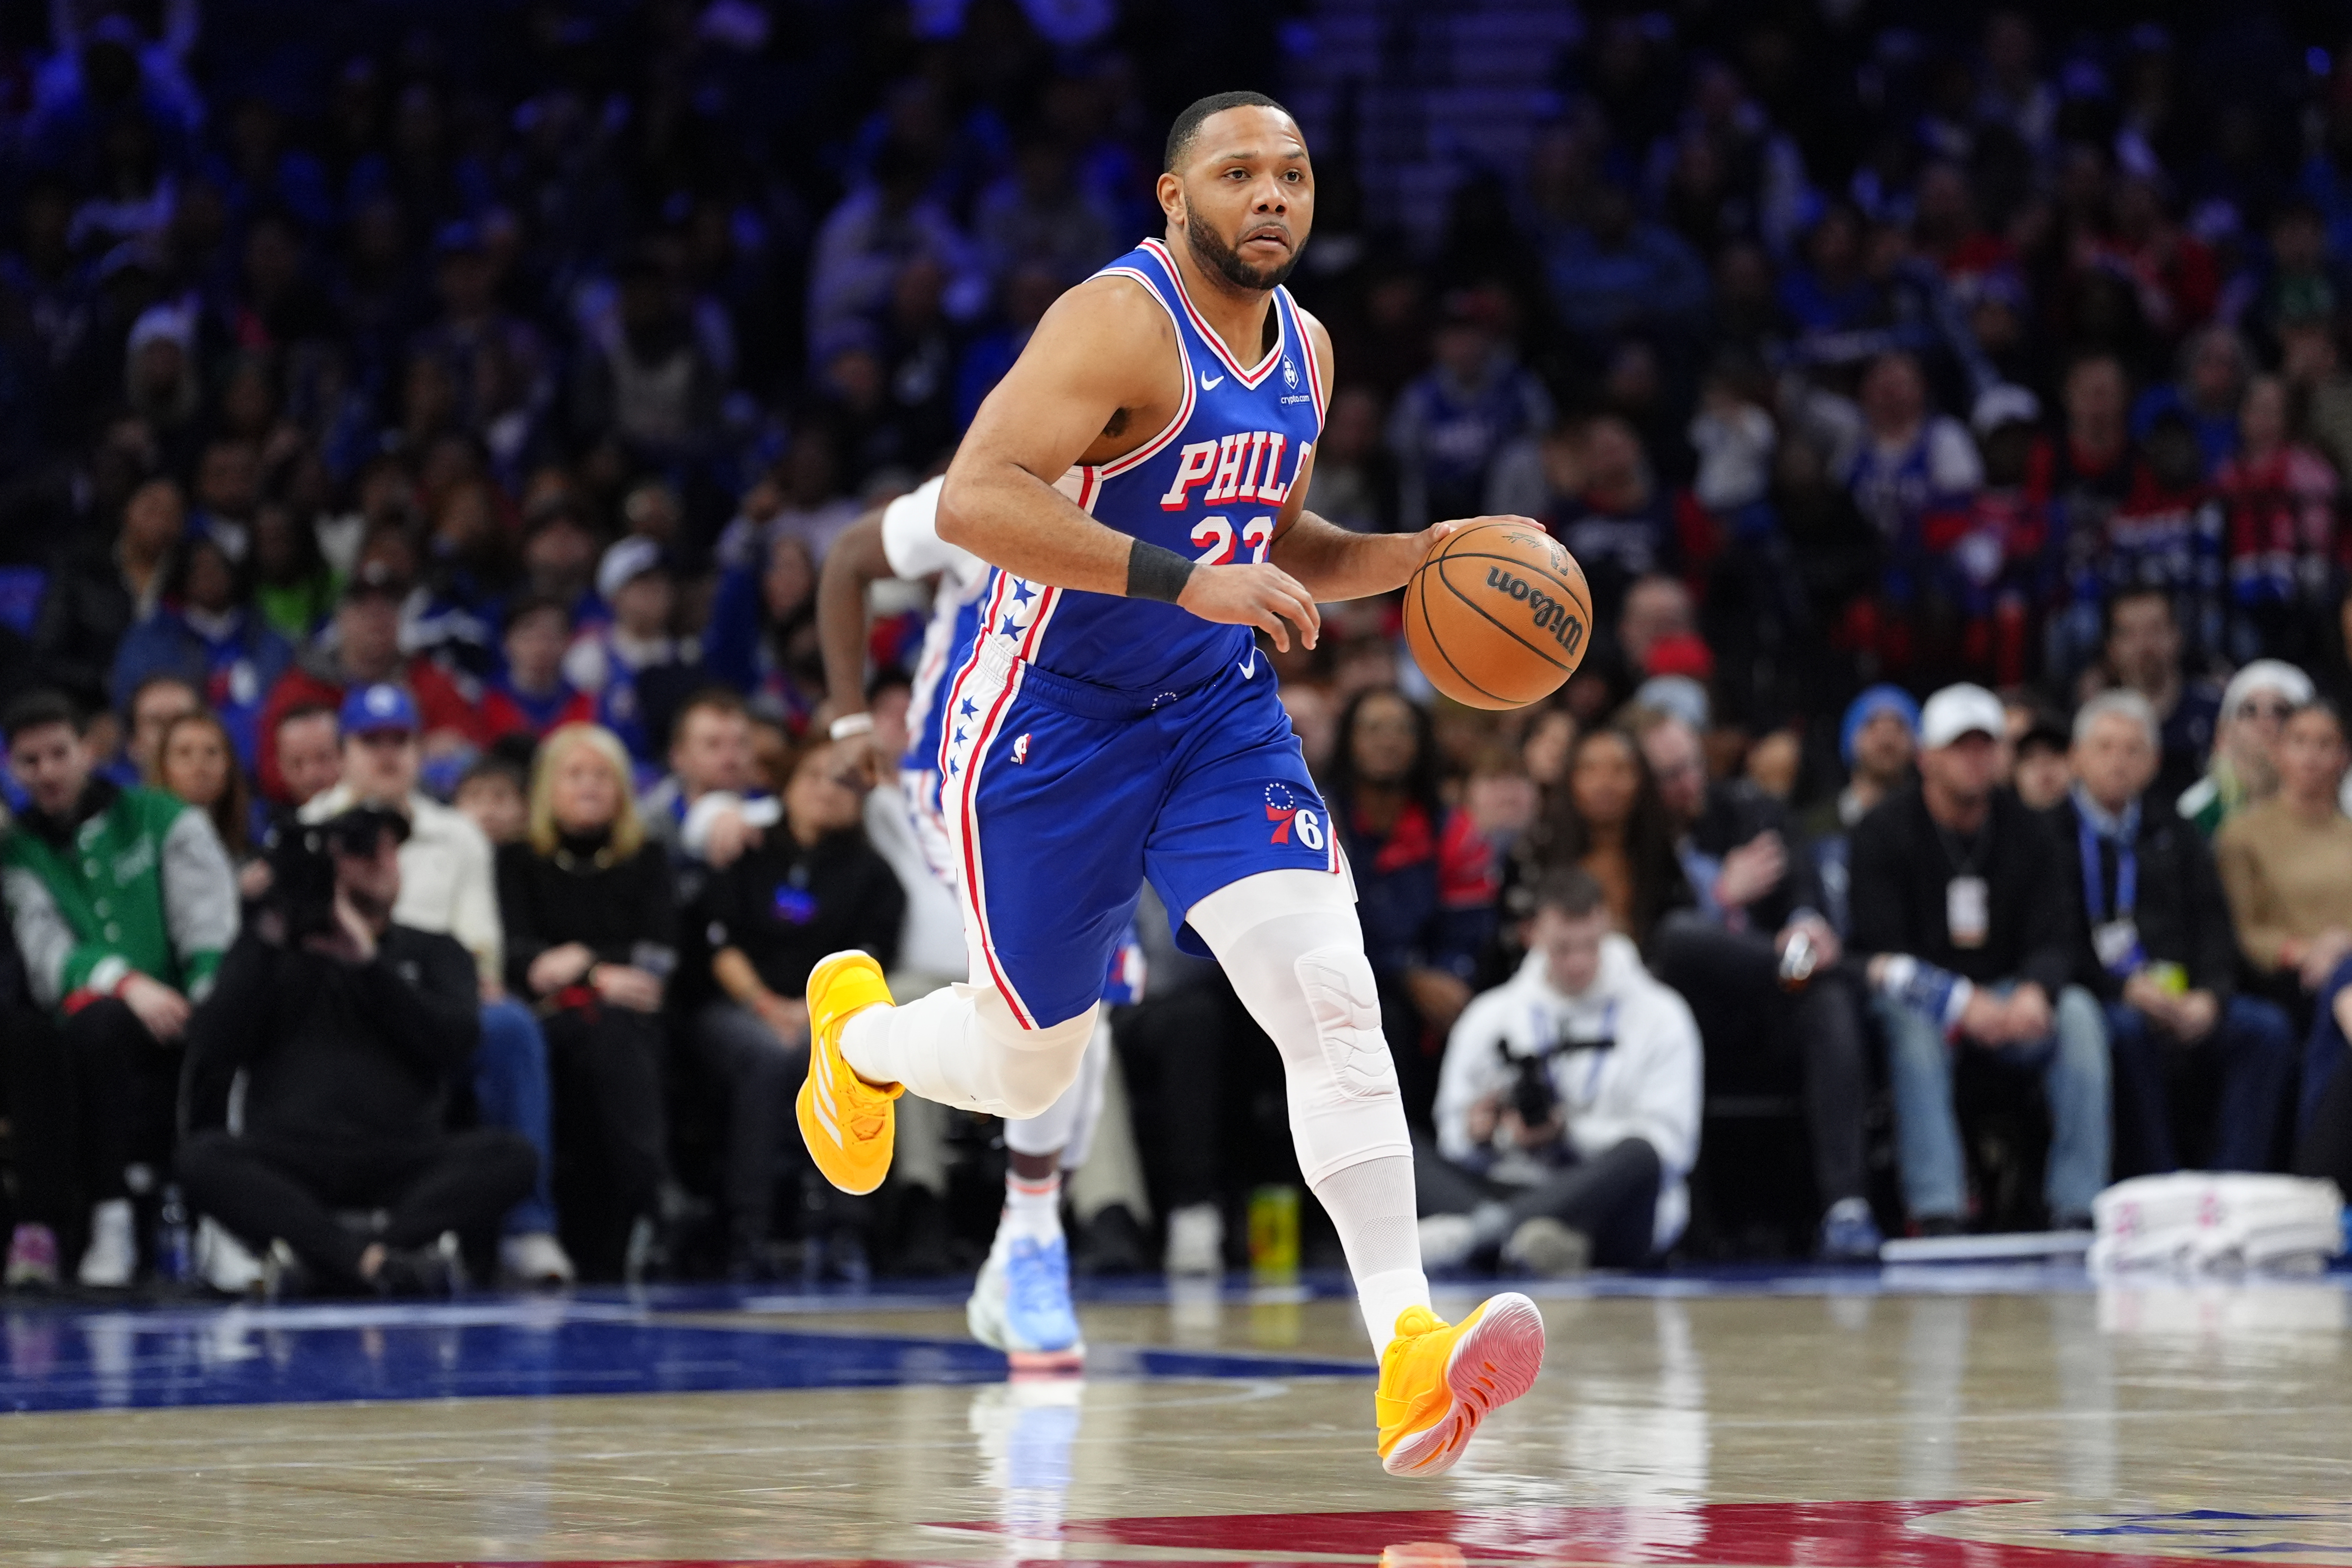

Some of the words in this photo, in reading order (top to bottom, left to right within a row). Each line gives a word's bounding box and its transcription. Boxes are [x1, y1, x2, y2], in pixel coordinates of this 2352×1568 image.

[1281, 395, 1310, 404] crypto.com
[1486, 566, 1582, 657] Wilson
[1265, 804, 1324, 850] 76
